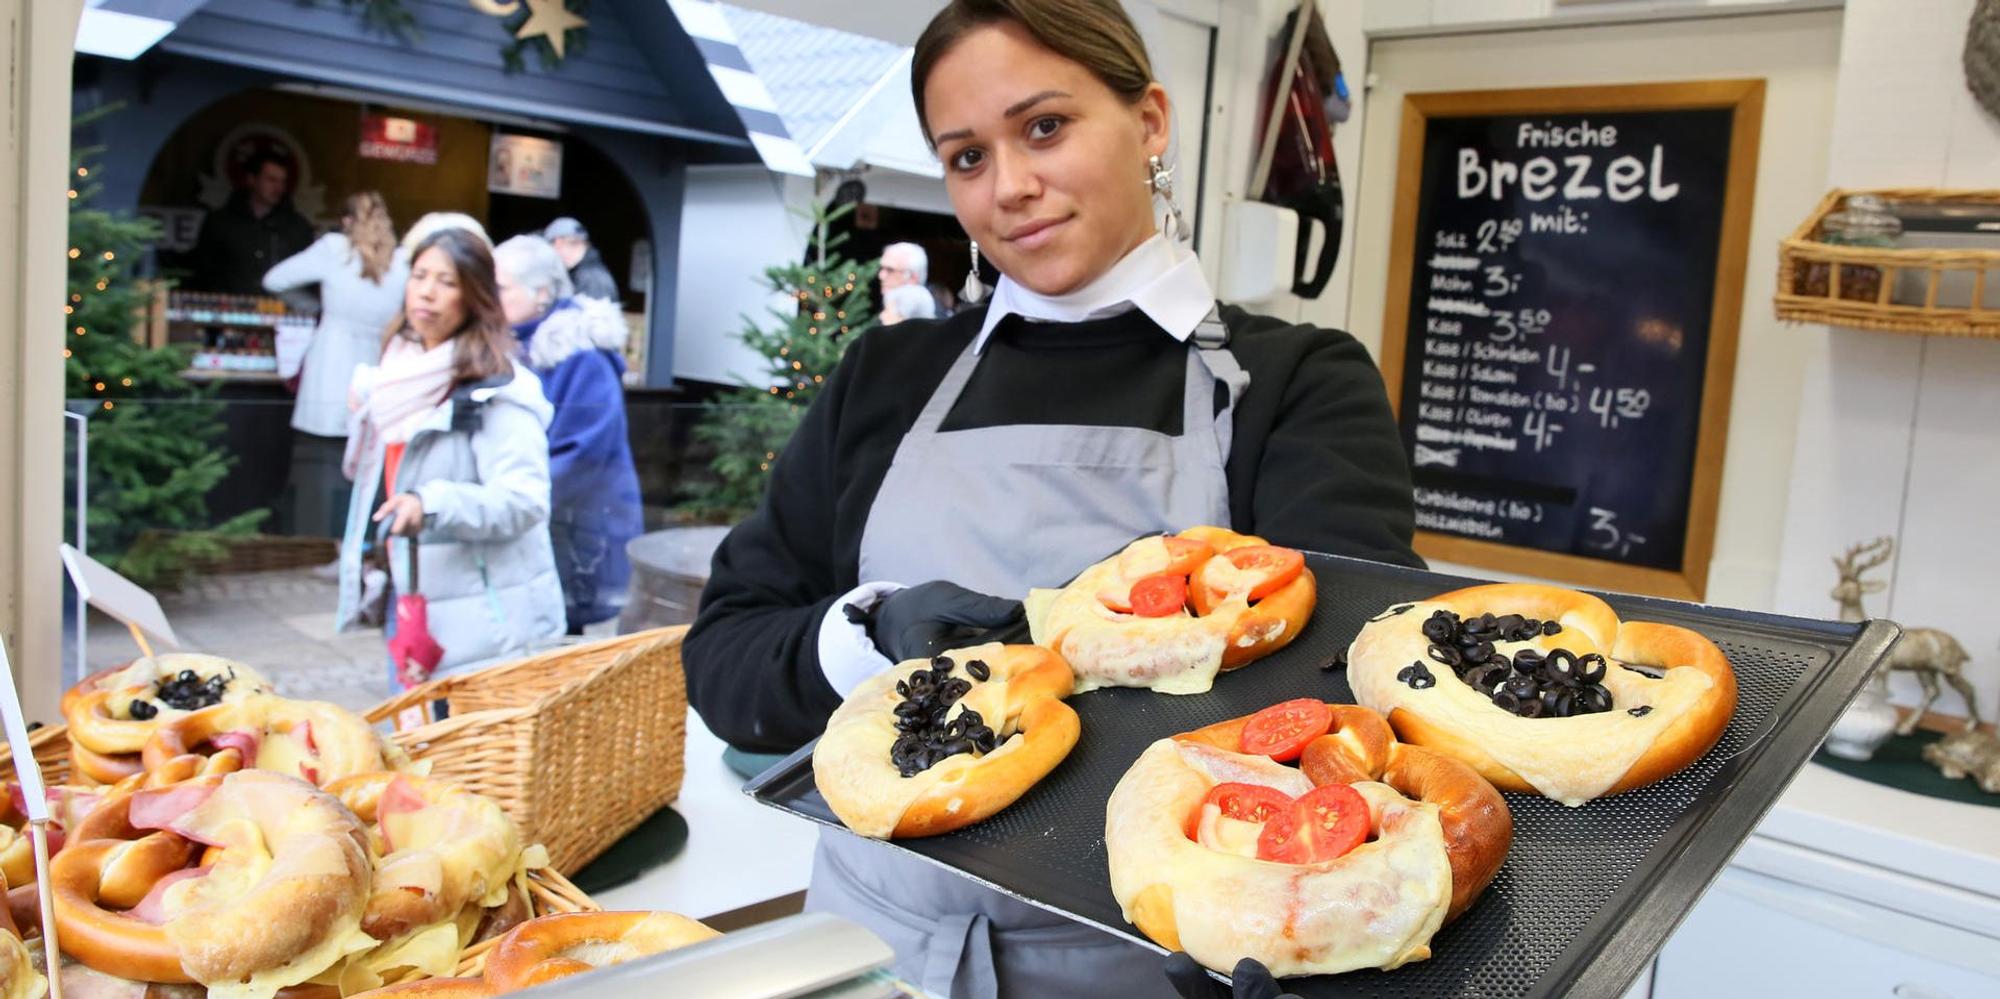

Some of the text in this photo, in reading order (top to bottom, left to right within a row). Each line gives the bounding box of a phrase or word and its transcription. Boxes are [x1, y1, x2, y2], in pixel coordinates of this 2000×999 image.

[1517, 119, 1617, 148] Frische
[1457, 144, 1680, 202] Brezel
[1530, 204, 1589, 233] mit:
[1434, 229, 1468, 248] Salz
[1430, 274, 1473, 292] Mohn
[1465, 406, 1513, 428] Oliven
